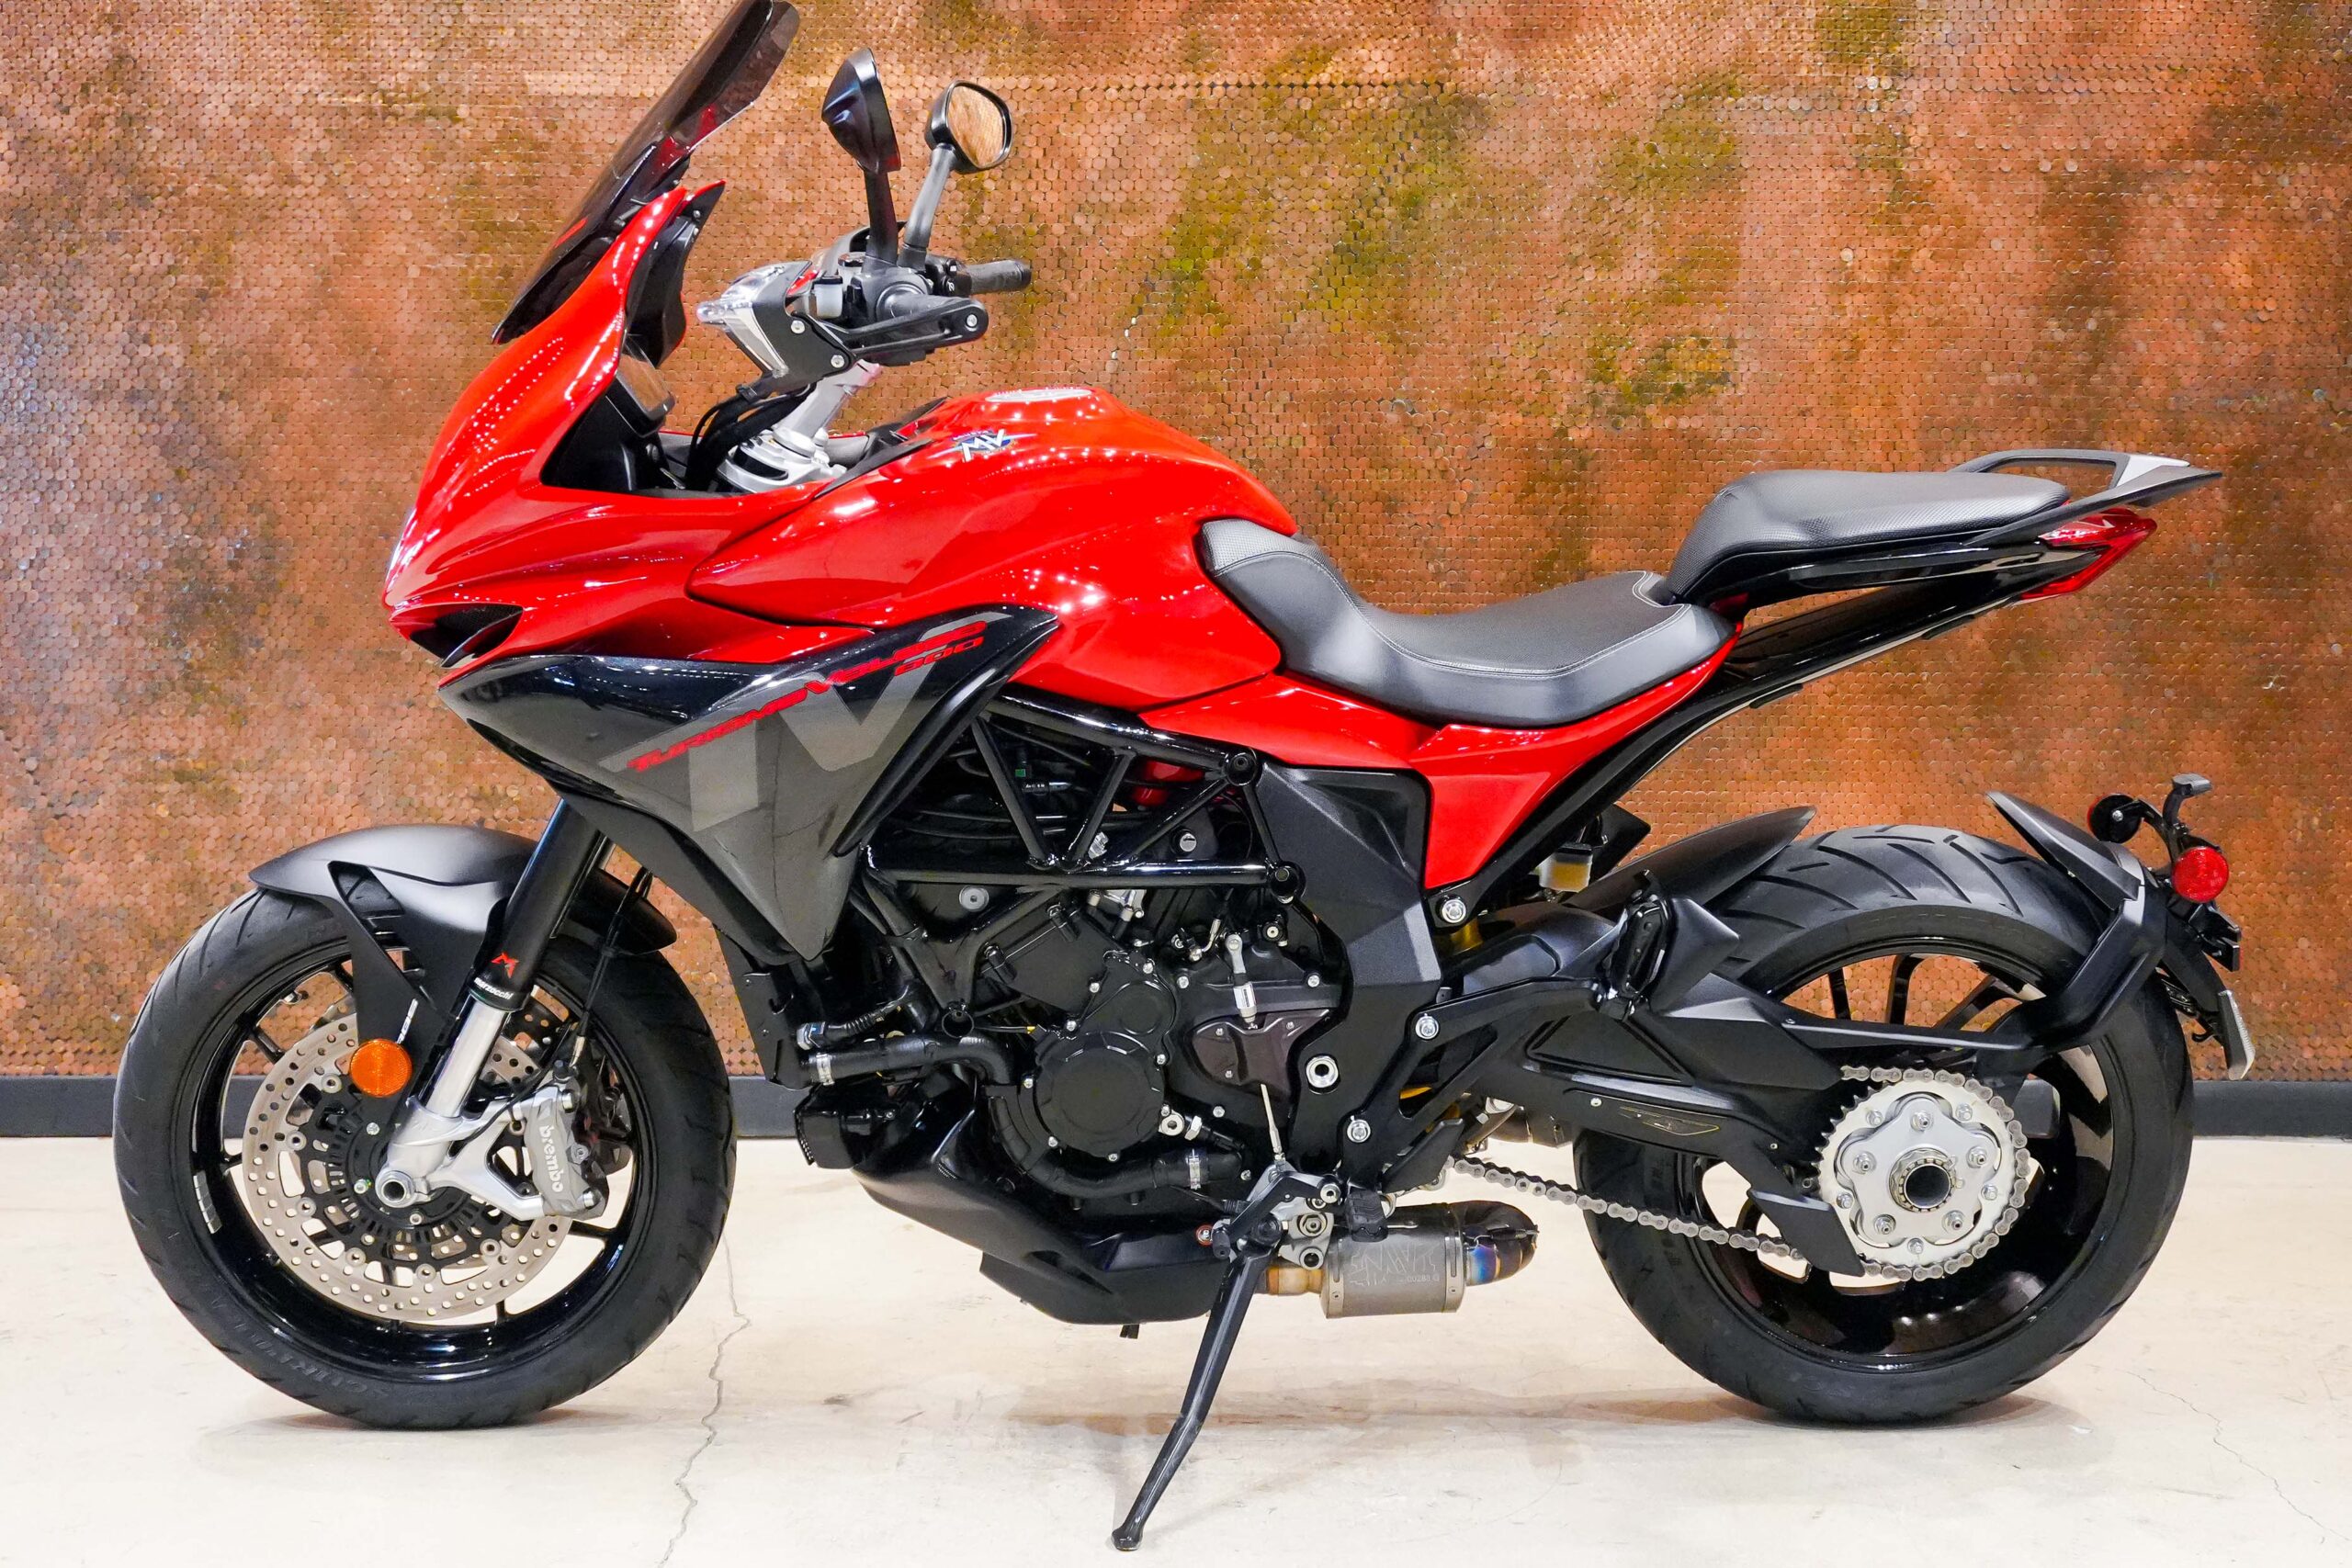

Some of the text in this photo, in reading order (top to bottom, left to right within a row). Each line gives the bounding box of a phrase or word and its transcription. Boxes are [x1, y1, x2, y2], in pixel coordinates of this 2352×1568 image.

[961, 429, 1006, 463] MV
[895, 636, 985, 677] 800
[474, 976, 514, 999] marzocchi
[538, 1124, 564, 1192] brembo
